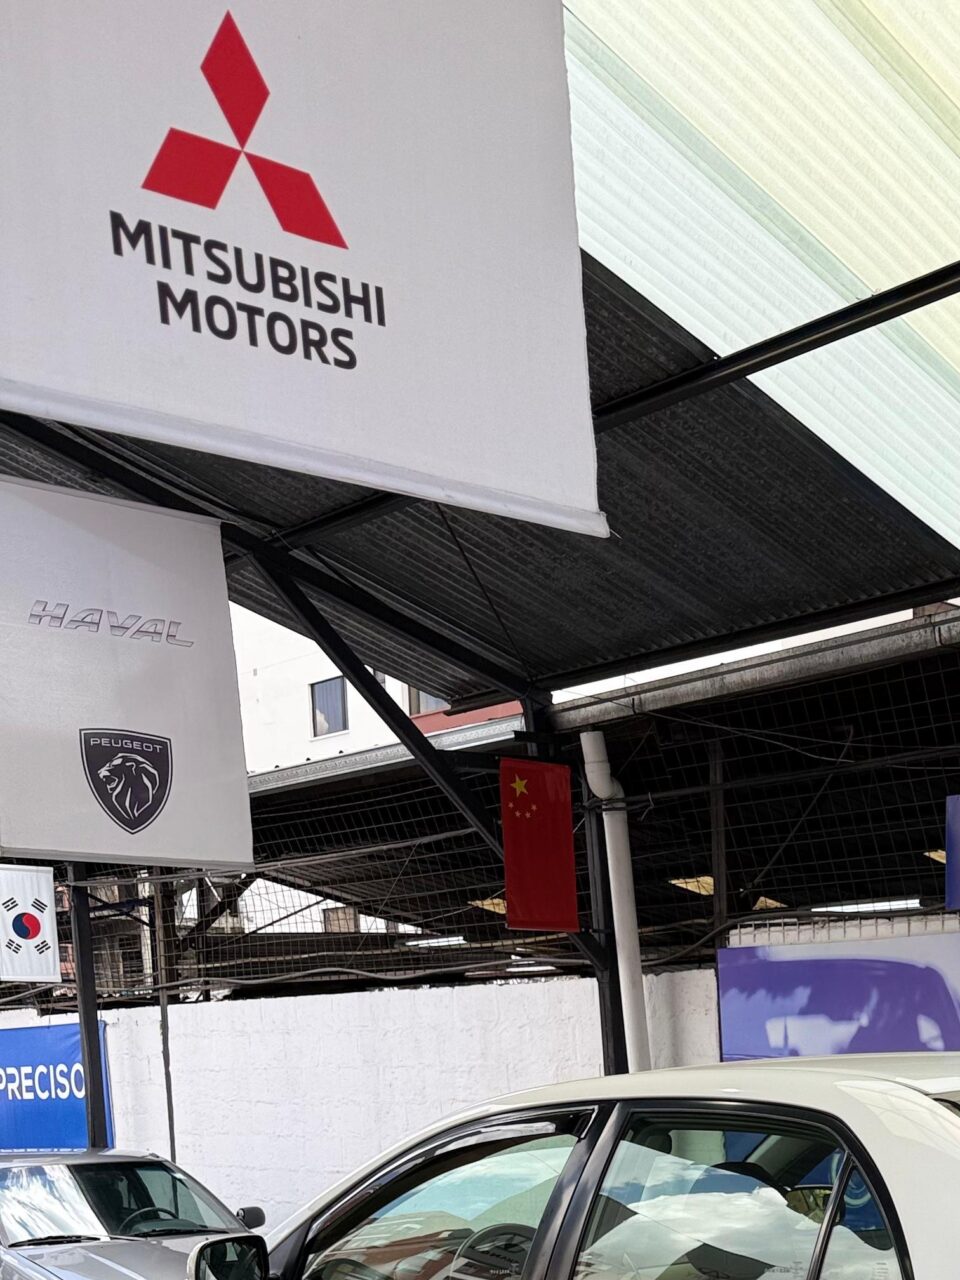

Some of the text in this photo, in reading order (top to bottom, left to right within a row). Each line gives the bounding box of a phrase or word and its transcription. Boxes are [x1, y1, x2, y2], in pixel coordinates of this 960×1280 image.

[110, 210, 387, 327] MITSUBISHI
[157, 280, 358, 370] MOTORS
[28, 600, 195, 648] HAVAL
[90, 738, 163, 753] PEUGEOT
